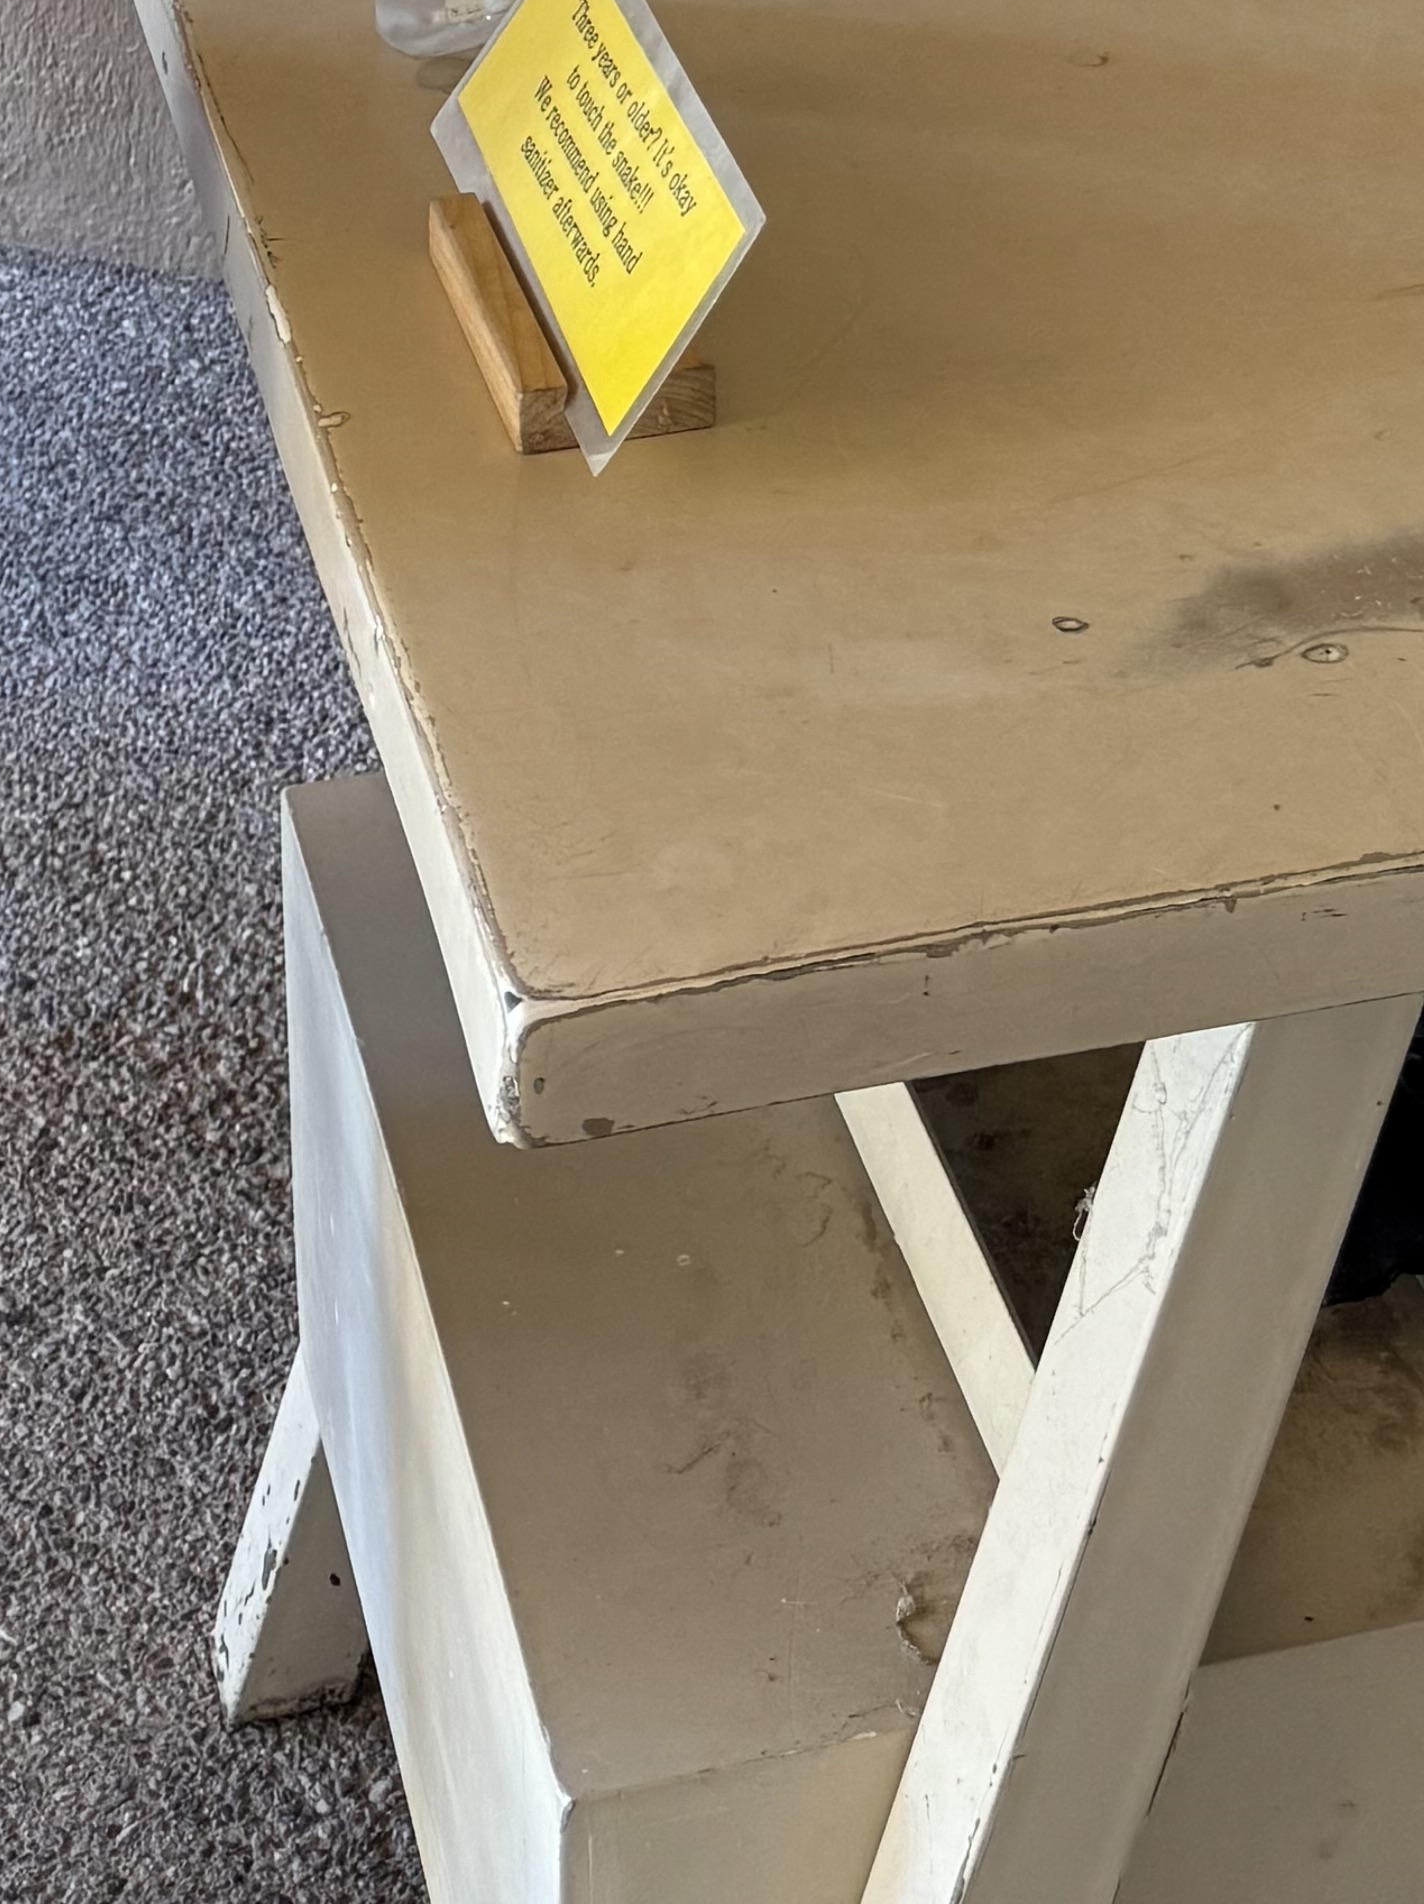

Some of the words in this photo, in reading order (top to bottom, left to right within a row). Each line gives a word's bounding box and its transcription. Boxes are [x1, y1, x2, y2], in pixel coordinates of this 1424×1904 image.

[534, 75, 552, 112] We
[546, 104, 599, 192] recommend
[590, 187, 618, 238] using
[613, 222, 643, 275] hand
[566, 65, 580, 90] to
[576, 80, 605, 132] touch
[598, 121, 617, 155] the
[612, 150, 655, 214] snake!!!
[592, 42, 621, 88] years
[616, 82, 632, 104] or
[627, 100, 663, 150] older?
[669, 172, 697, 216] okay
[521, 136, 559, 200] sanitizer
[553, 196, 599, 288] afterwards.
